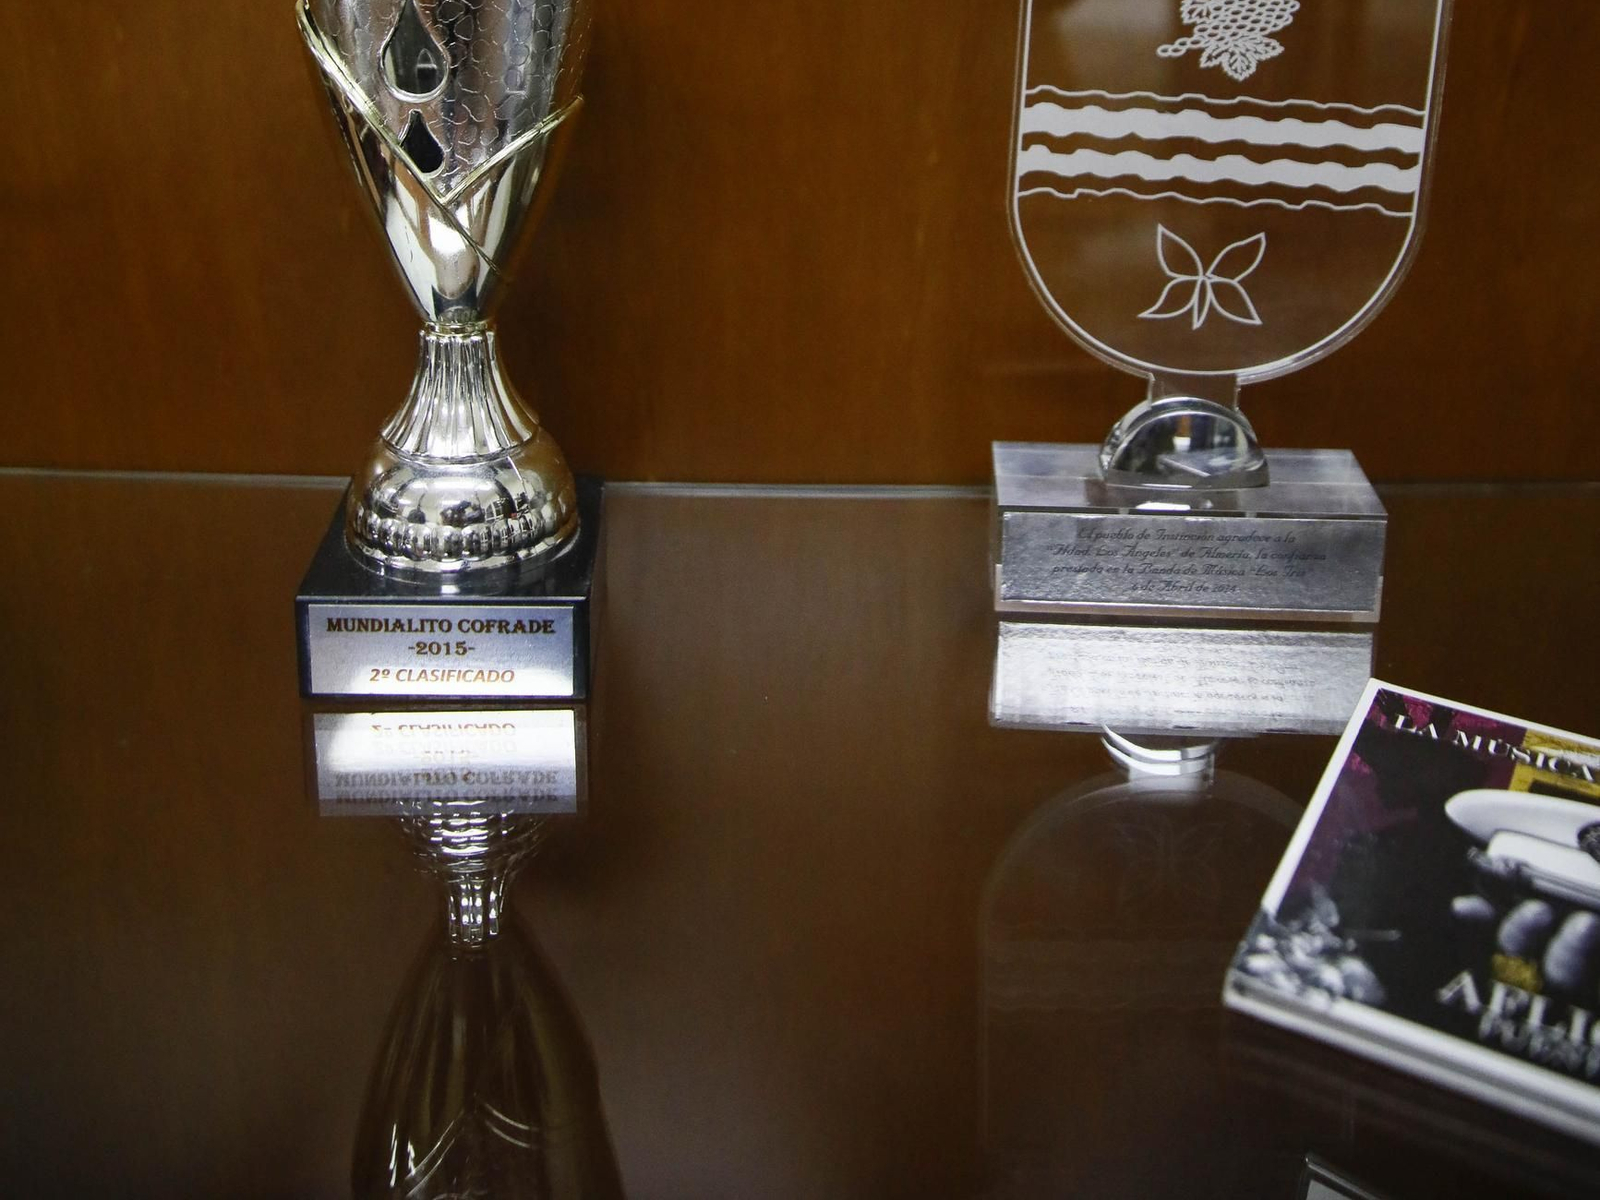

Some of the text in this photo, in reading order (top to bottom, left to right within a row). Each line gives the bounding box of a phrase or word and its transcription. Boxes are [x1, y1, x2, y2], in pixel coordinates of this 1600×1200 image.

[1094, 527, 1134, 543] pueblo
[1136, 528, 1151, 540] de
[1283, 531, 1296, 544] la
[1095, 545, 1118, 557] Los
[1180, 546, 1196, 558] de
[1255, 547, 1269, 560] la
[1051, 561, 1103, 577] prestada
[1105, 566, 1120, 574] en
[1123, 563, 1135, 575] la
[1137, 562, 1181, 575] Banda
[1182, 564, 1198, 576] de
[1140, 579, 1156, 592] de
[1157, 580, 1195, 593] Abril
[1195, 580, 1209, 593] de
[326, 616, 556, 635] MUNDIALITO COFRADE
[407, 640, 476, 656] -2015-
[369, 667, 516, 684] 2º CLASIFICADO
[1394, 714, 1440, 740] LA
